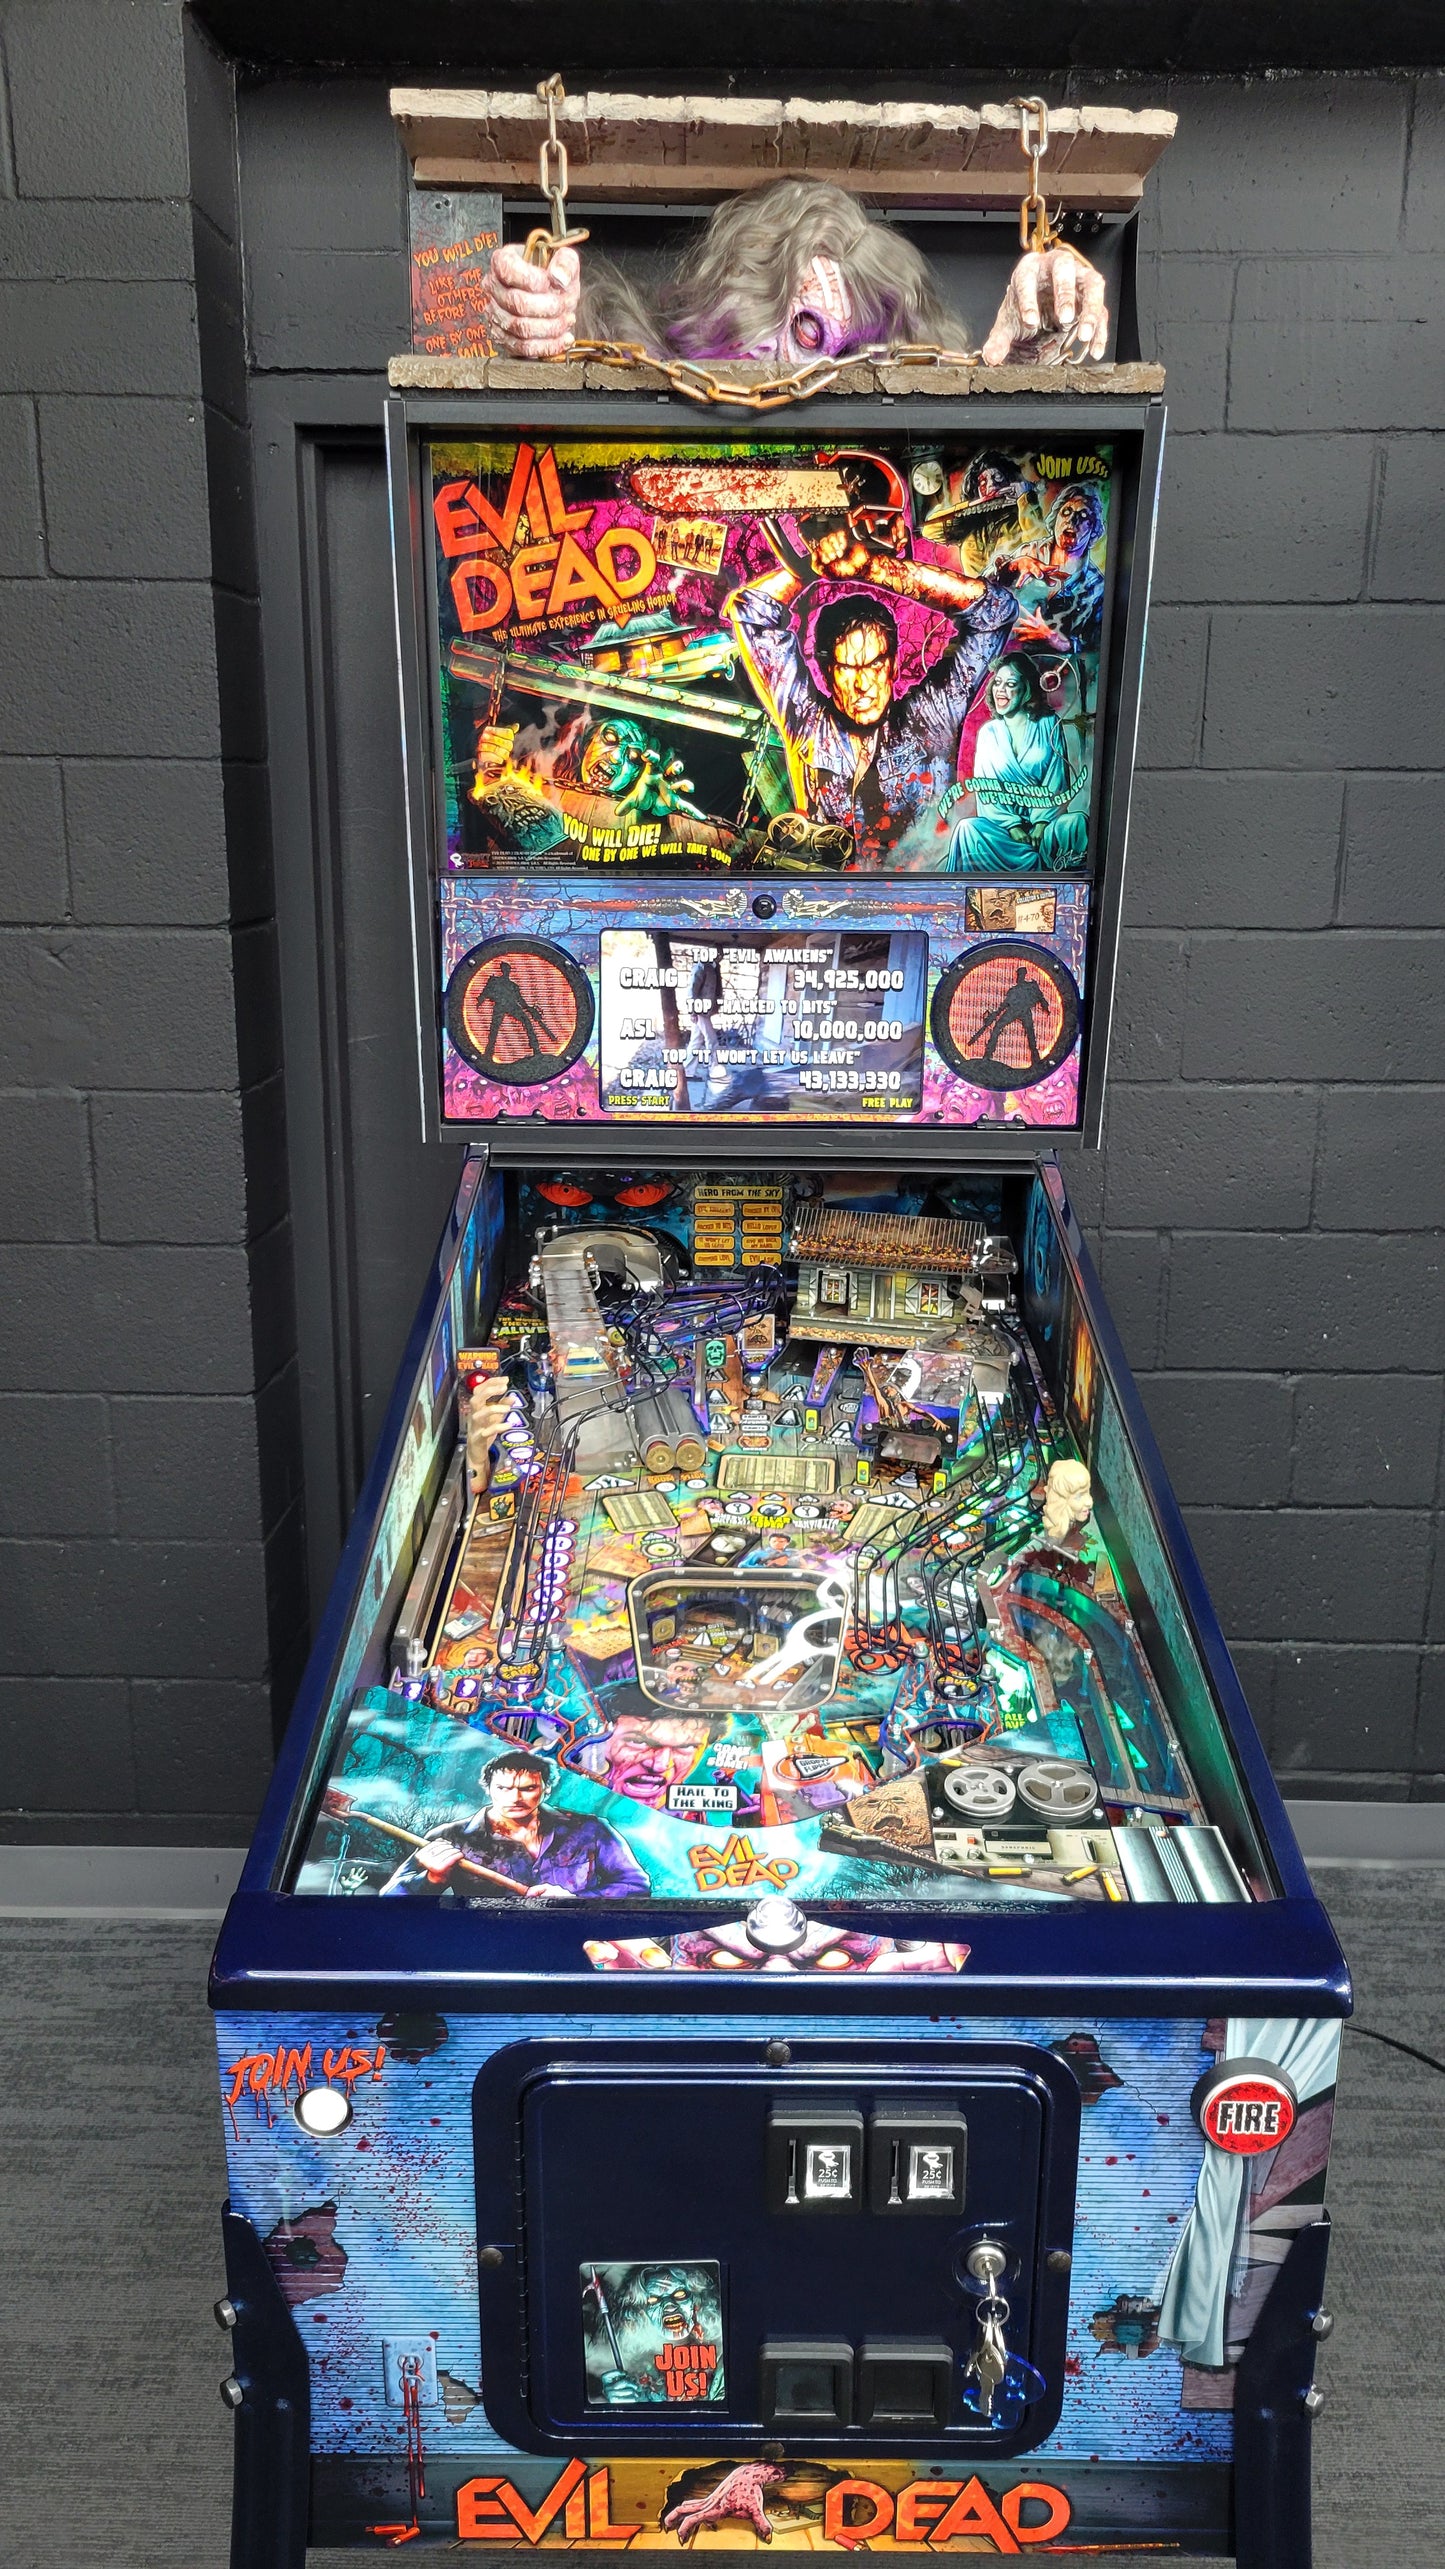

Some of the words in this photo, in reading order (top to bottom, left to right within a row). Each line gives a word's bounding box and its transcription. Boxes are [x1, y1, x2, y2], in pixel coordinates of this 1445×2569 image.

[414, 249, 438, 267] YOU
[443, 242, 473, 263] WILL
[474, 233, 498, 249] DIE!
[429, 276, 454, 295] LIKE
[460, 268, 482, 285] THE
[438, 285, 483, 306] OTHERS
[424, 304, 465, 325] BEFORE
[425, 336, 447, 353] ONE
[450, 330, 463, 347] BY
[466, 324, 487, 340] ONE
[1036, 453, 1072, 479] JOIN
[434, 441, 595, 558] EVIL
[450, 527, 657, 633] DEAD
[492, 628, 508, 643] THE
[510, 620, 548, 637] ULTIMATE
[549, 611, 596, 631] EXPERIENCE
[597, 608, 607, 621] IN
[608, 601, 646, 620] GRUELING
[647, 593, 678, 609] HORROR
[937, 781, 965, 819] WE'RE
[965, 777, 1002, 793] GONNA
[1004, 781, 1024, 795] GET
[1015, 795, 1052, 808] GONNA
[1055, 790, 1071, 806] GET
[1072, 765, 1088, 797] YOU
[563, 813, 589, 843] YOU
[592, 827, 622, 848] WILL
[626, 823, 662, 848] DIE!
[582, 845, 601, 862] ONE
[603, 847, 618, 862] BY
[619, 846, 639, 862] ONE
[642, 844, 657, 858] WE
[660, 842, 683, 855] WILL
[687, 842, 708, 856] TAKE
[711, 847, 732, 866] YOU!
[692, 948, 717, 963] TOP
[723, 948, 760, 963] "EVIL
[763, 949, 834, 964] AWAKENS"
[619, 967, 679, 988] CRAIG
[793, 969, 904, 991] 34,925,000
[686, 999, 712, 1015] TOP
[718, 1000, 775, 1015] "HACKED
[780, 1000, 798, 1014] TO
[802, 1000, 838, 1015] BITS"
[620, 1018, 655, 1040] ASL
[793, 1020, 903, 1042] 10,000,000
[662, 1049, 686, 1064] TOP
[717, 1050, 757, 1065] WON'T
[763, 1050, 785, 1065] LET
[790, 1050, 808, 1065] US
[812, 1050, 861, 1065] LEAVE"
[619, 1069, 678, 1090] CRAIG
[799, 1070, 901, 1091] 43,133,330
[608, 1094, 640, 1106] PRESS
[642, 1095, 670, 1106] START
[862, 1096, 886, 1108] FREE
[889, 1097, 913, 1108] PLAY
[698, 1189, 719, 1197] HERO
[721, 1189, 744, 1197] FROM
[747, 1189, 761, 1197] THE
[764, 1189, 781, 1197] SKY
[458, 1352, 498, 1361] WARNING
[444, 1668, 485, 1679] SANIT
[713, 1743, 752, 1756] COME
[716, 1751, 741, 1762] GET
[673, 1798, 698, 1809] THE
[702, 1798, 734, 1809] KING
[677, 1787, 706, 1797] HAIL
[713, 1787, 730, 1797] TO
[689, 1834, 768, 1870] EVIL
[695, 1858, 800, 1892] DEAD
[224, 2040, 313, 2106] JOIN
[322, 2046, 387, 2083] US!
[1217, 2101, 1281, 2134] FIRE
[818, 2169, 838, 2178] 25¢
[922, 2170, 942, 2179] 25¢
[654, 2343, 717, 2371] JOIN
[666, 2370, 708, 2397] US!
[456, 2456, 643, 2546] EVIL
[824, 2475, 1072, 2553] DEAD
